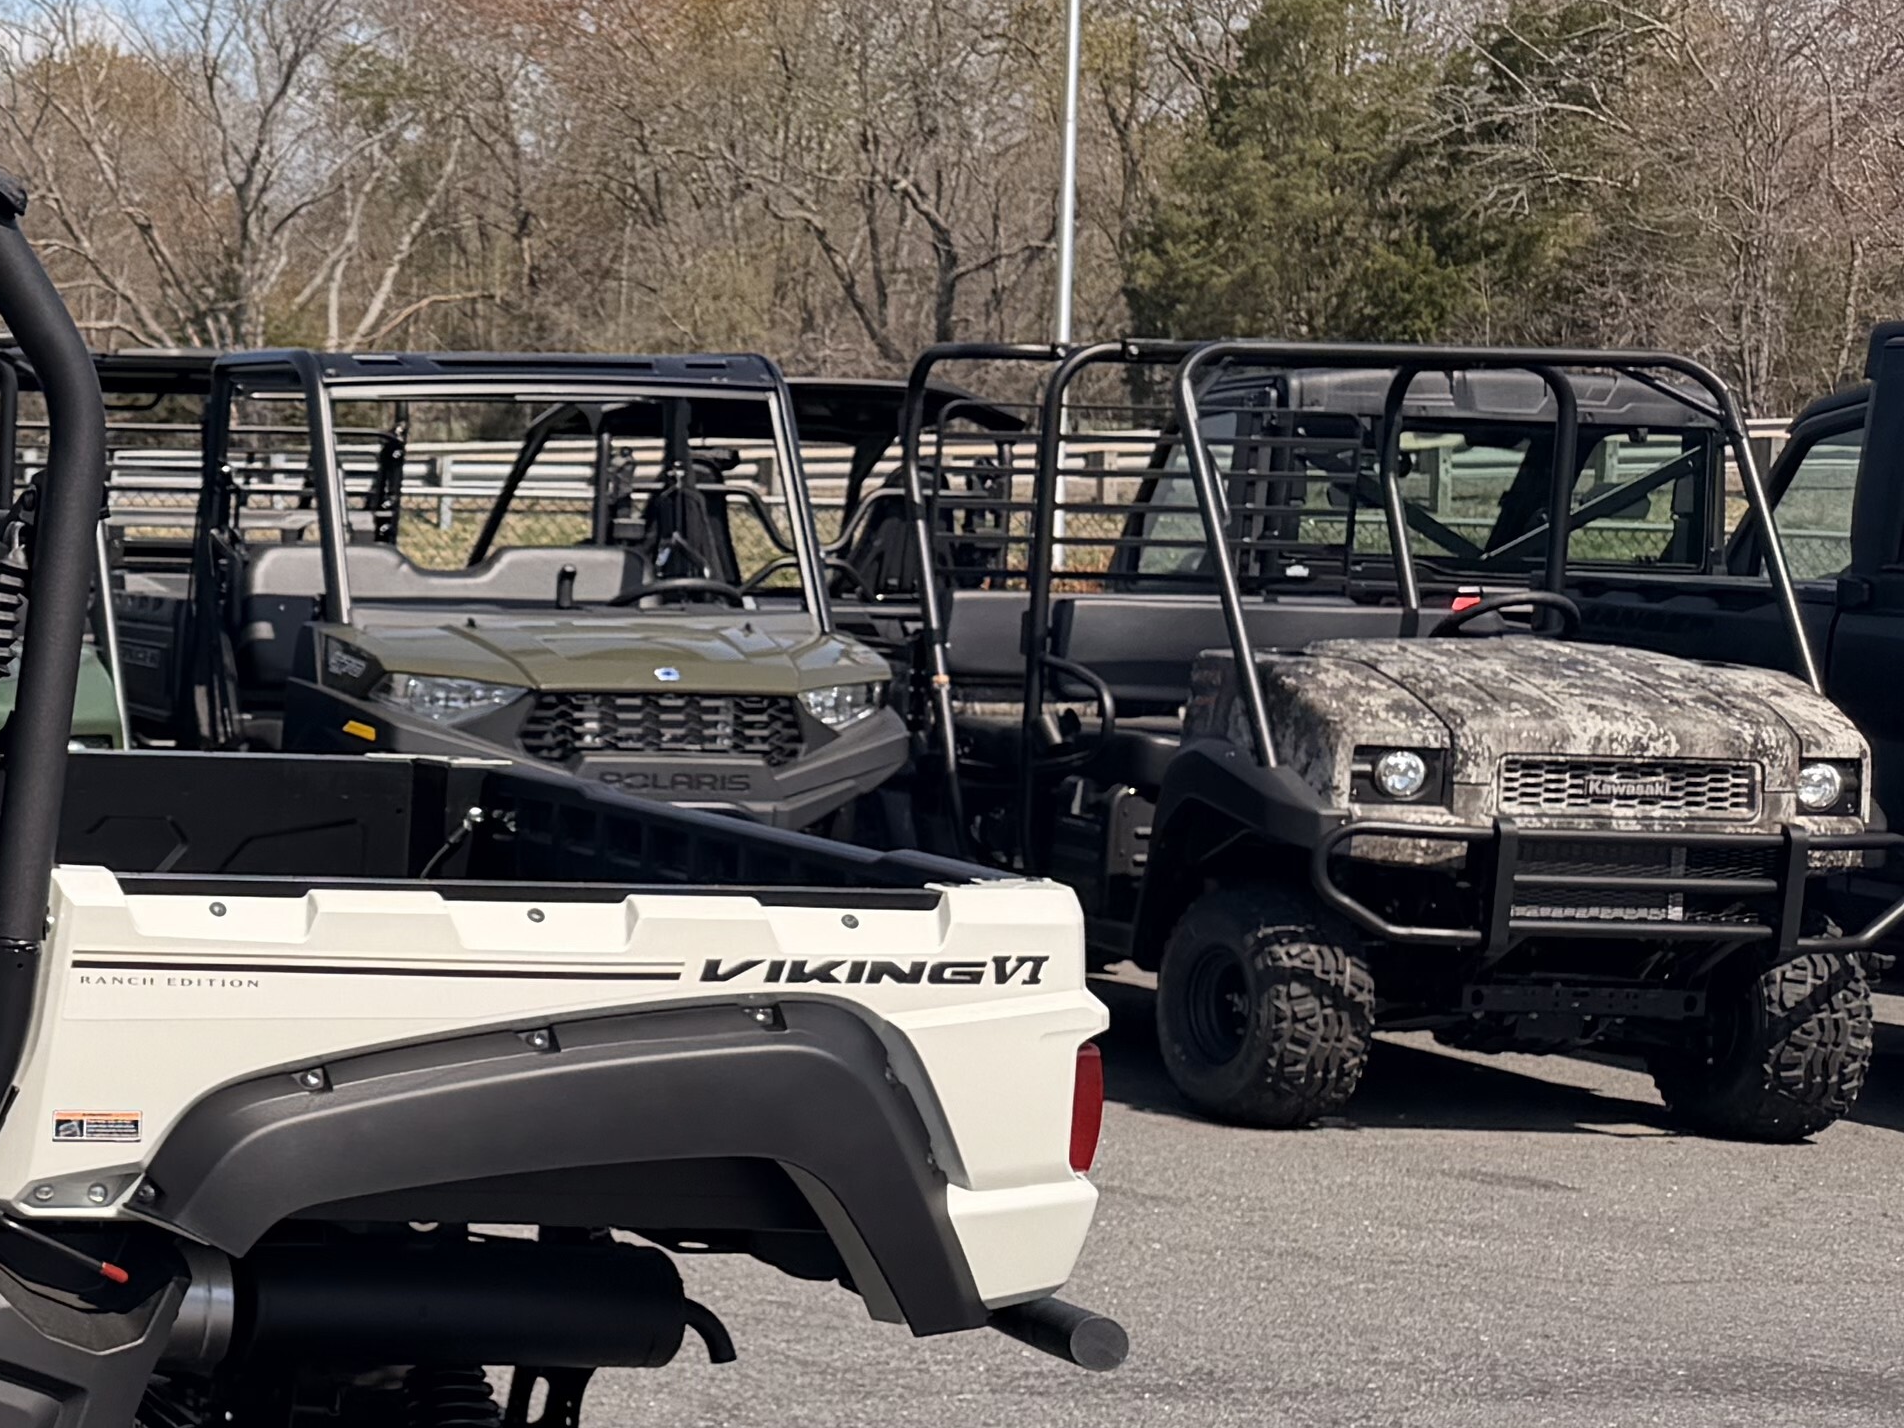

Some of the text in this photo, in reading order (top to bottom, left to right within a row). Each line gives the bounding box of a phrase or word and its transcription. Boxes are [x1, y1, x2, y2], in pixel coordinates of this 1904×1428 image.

[598, 771, 752, 792] POLARIS
[1588, 779, 1671, 796] Kawasaki
[698, 958, 988, 985] VIKING
[79, 975, 261, 988] RANCH EDITION
